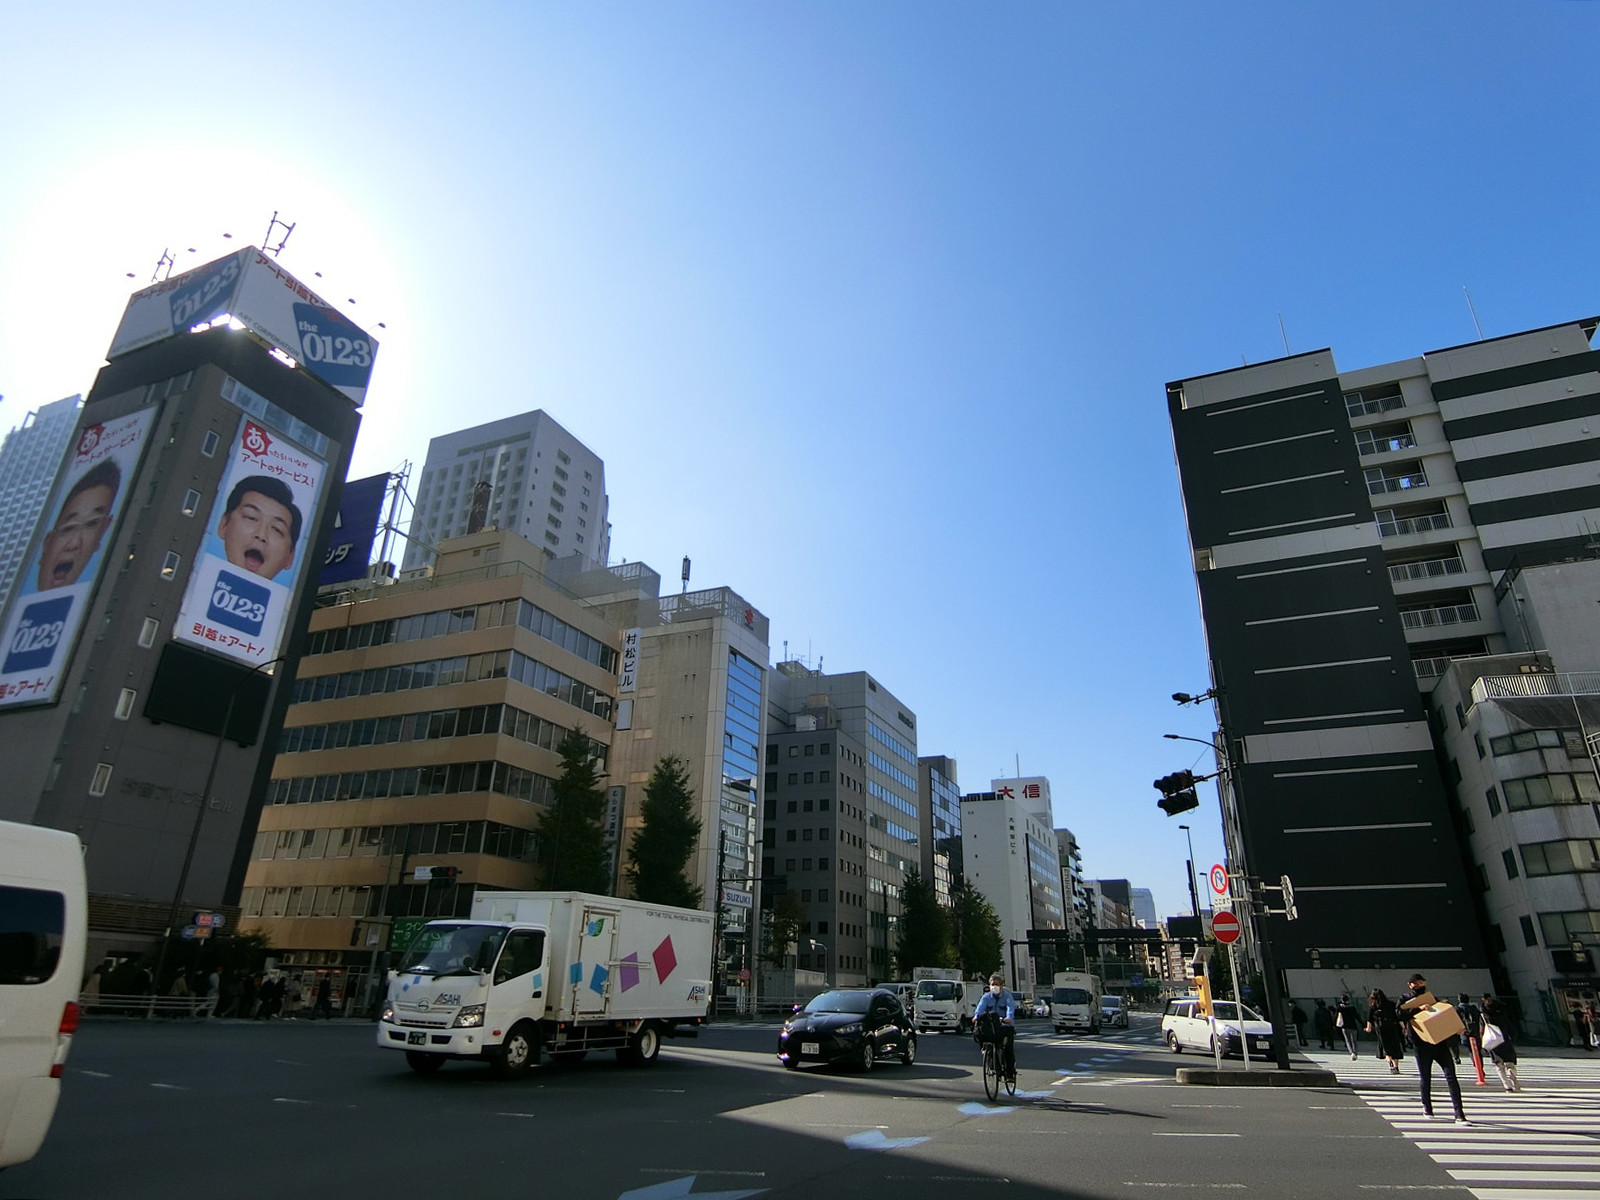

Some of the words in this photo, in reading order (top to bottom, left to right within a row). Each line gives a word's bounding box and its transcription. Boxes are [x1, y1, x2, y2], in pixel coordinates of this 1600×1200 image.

[173, 257, 239, 326] 0123
[253, 322, 300, 357] CORPORATION
[299, 321, 318, 331] the
[302, 332, 372, 367] 0123
[241, 453, 315, 488] アートのサービス!
[216, 581, 232, 592] the
[212, 589, 265, 622] 0123
[11, 621, 64, 654] 0123
[192, 622, 266, 657] 引越はアート!
[621, 633, 637, 688] 村松ビル
[998, 784, 1041, 800] 大信
[726, 892, 751, 905] SUZUKI
[432, 992, 462, 1006] ASAHI
